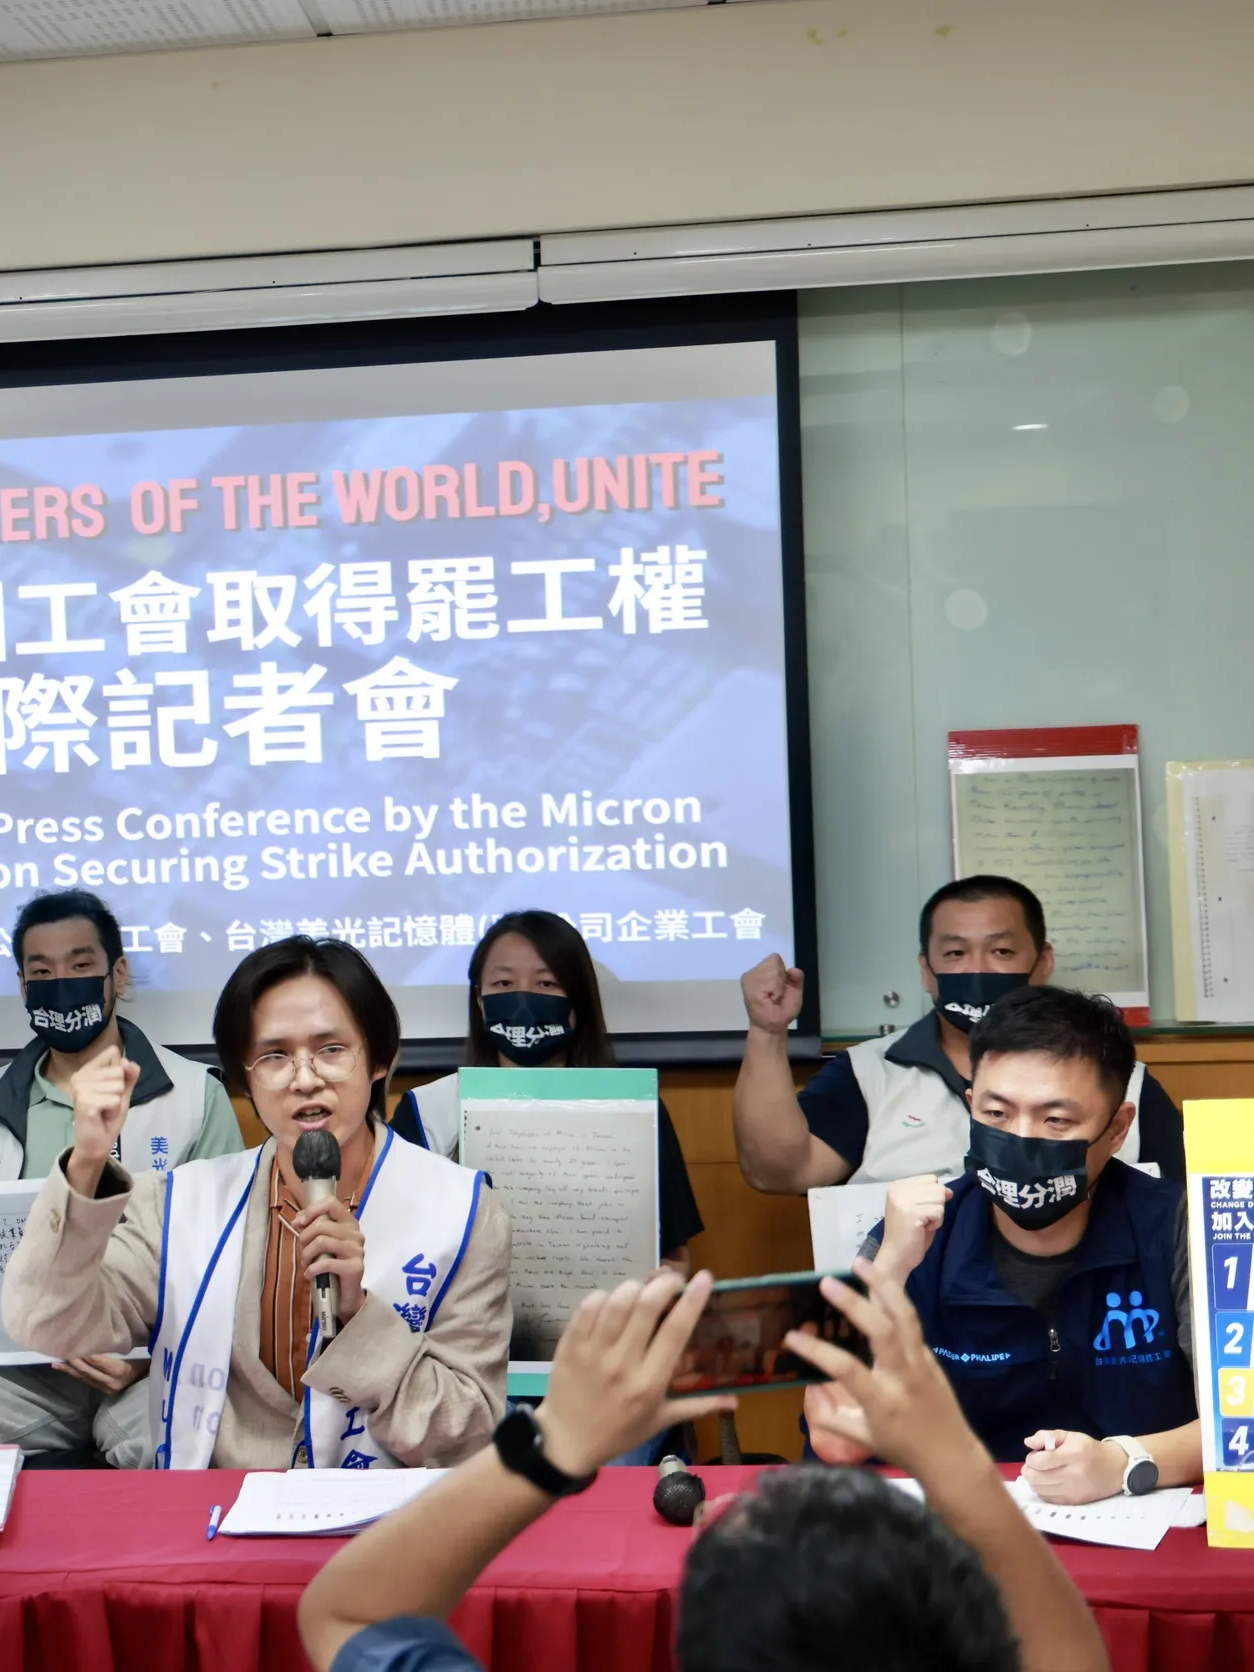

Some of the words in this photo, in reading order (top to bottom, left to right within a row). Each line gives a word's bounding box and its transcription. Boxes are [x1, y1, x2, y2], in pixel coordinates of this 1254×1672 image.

[131, 477, 199, 534] OF
[212, 472, 319, 531] THE
[116, 799, 371, 842] Conference
[384, 796, 439, 838] by
[451, 793, 528, 830] the
[542, 790, 701, 828] Micron
[53, 846, 249, 890] Securing
[261, 841, 393, 881] Strike
[405, 833, 728, 877] Authorization
[33, 1003, 103, 1033] 合理分潤
[976, 1167, 1077, 1210] 合理分潤
[1210, 1201, 1245, 1209] CHANGE
[1211, 1211, 1254, 1232] 加入
[1212, 1232, 1233, 1240] JOIN
[1234, 1232, 1252, 1240] THE
[1223, 1256, 1238, 1289] 1
[1224, 1322, 1244, 1354] 2
[1226, 1376, 1246, 1406] 3
[1229, 1426, 1249, 1455] 4
